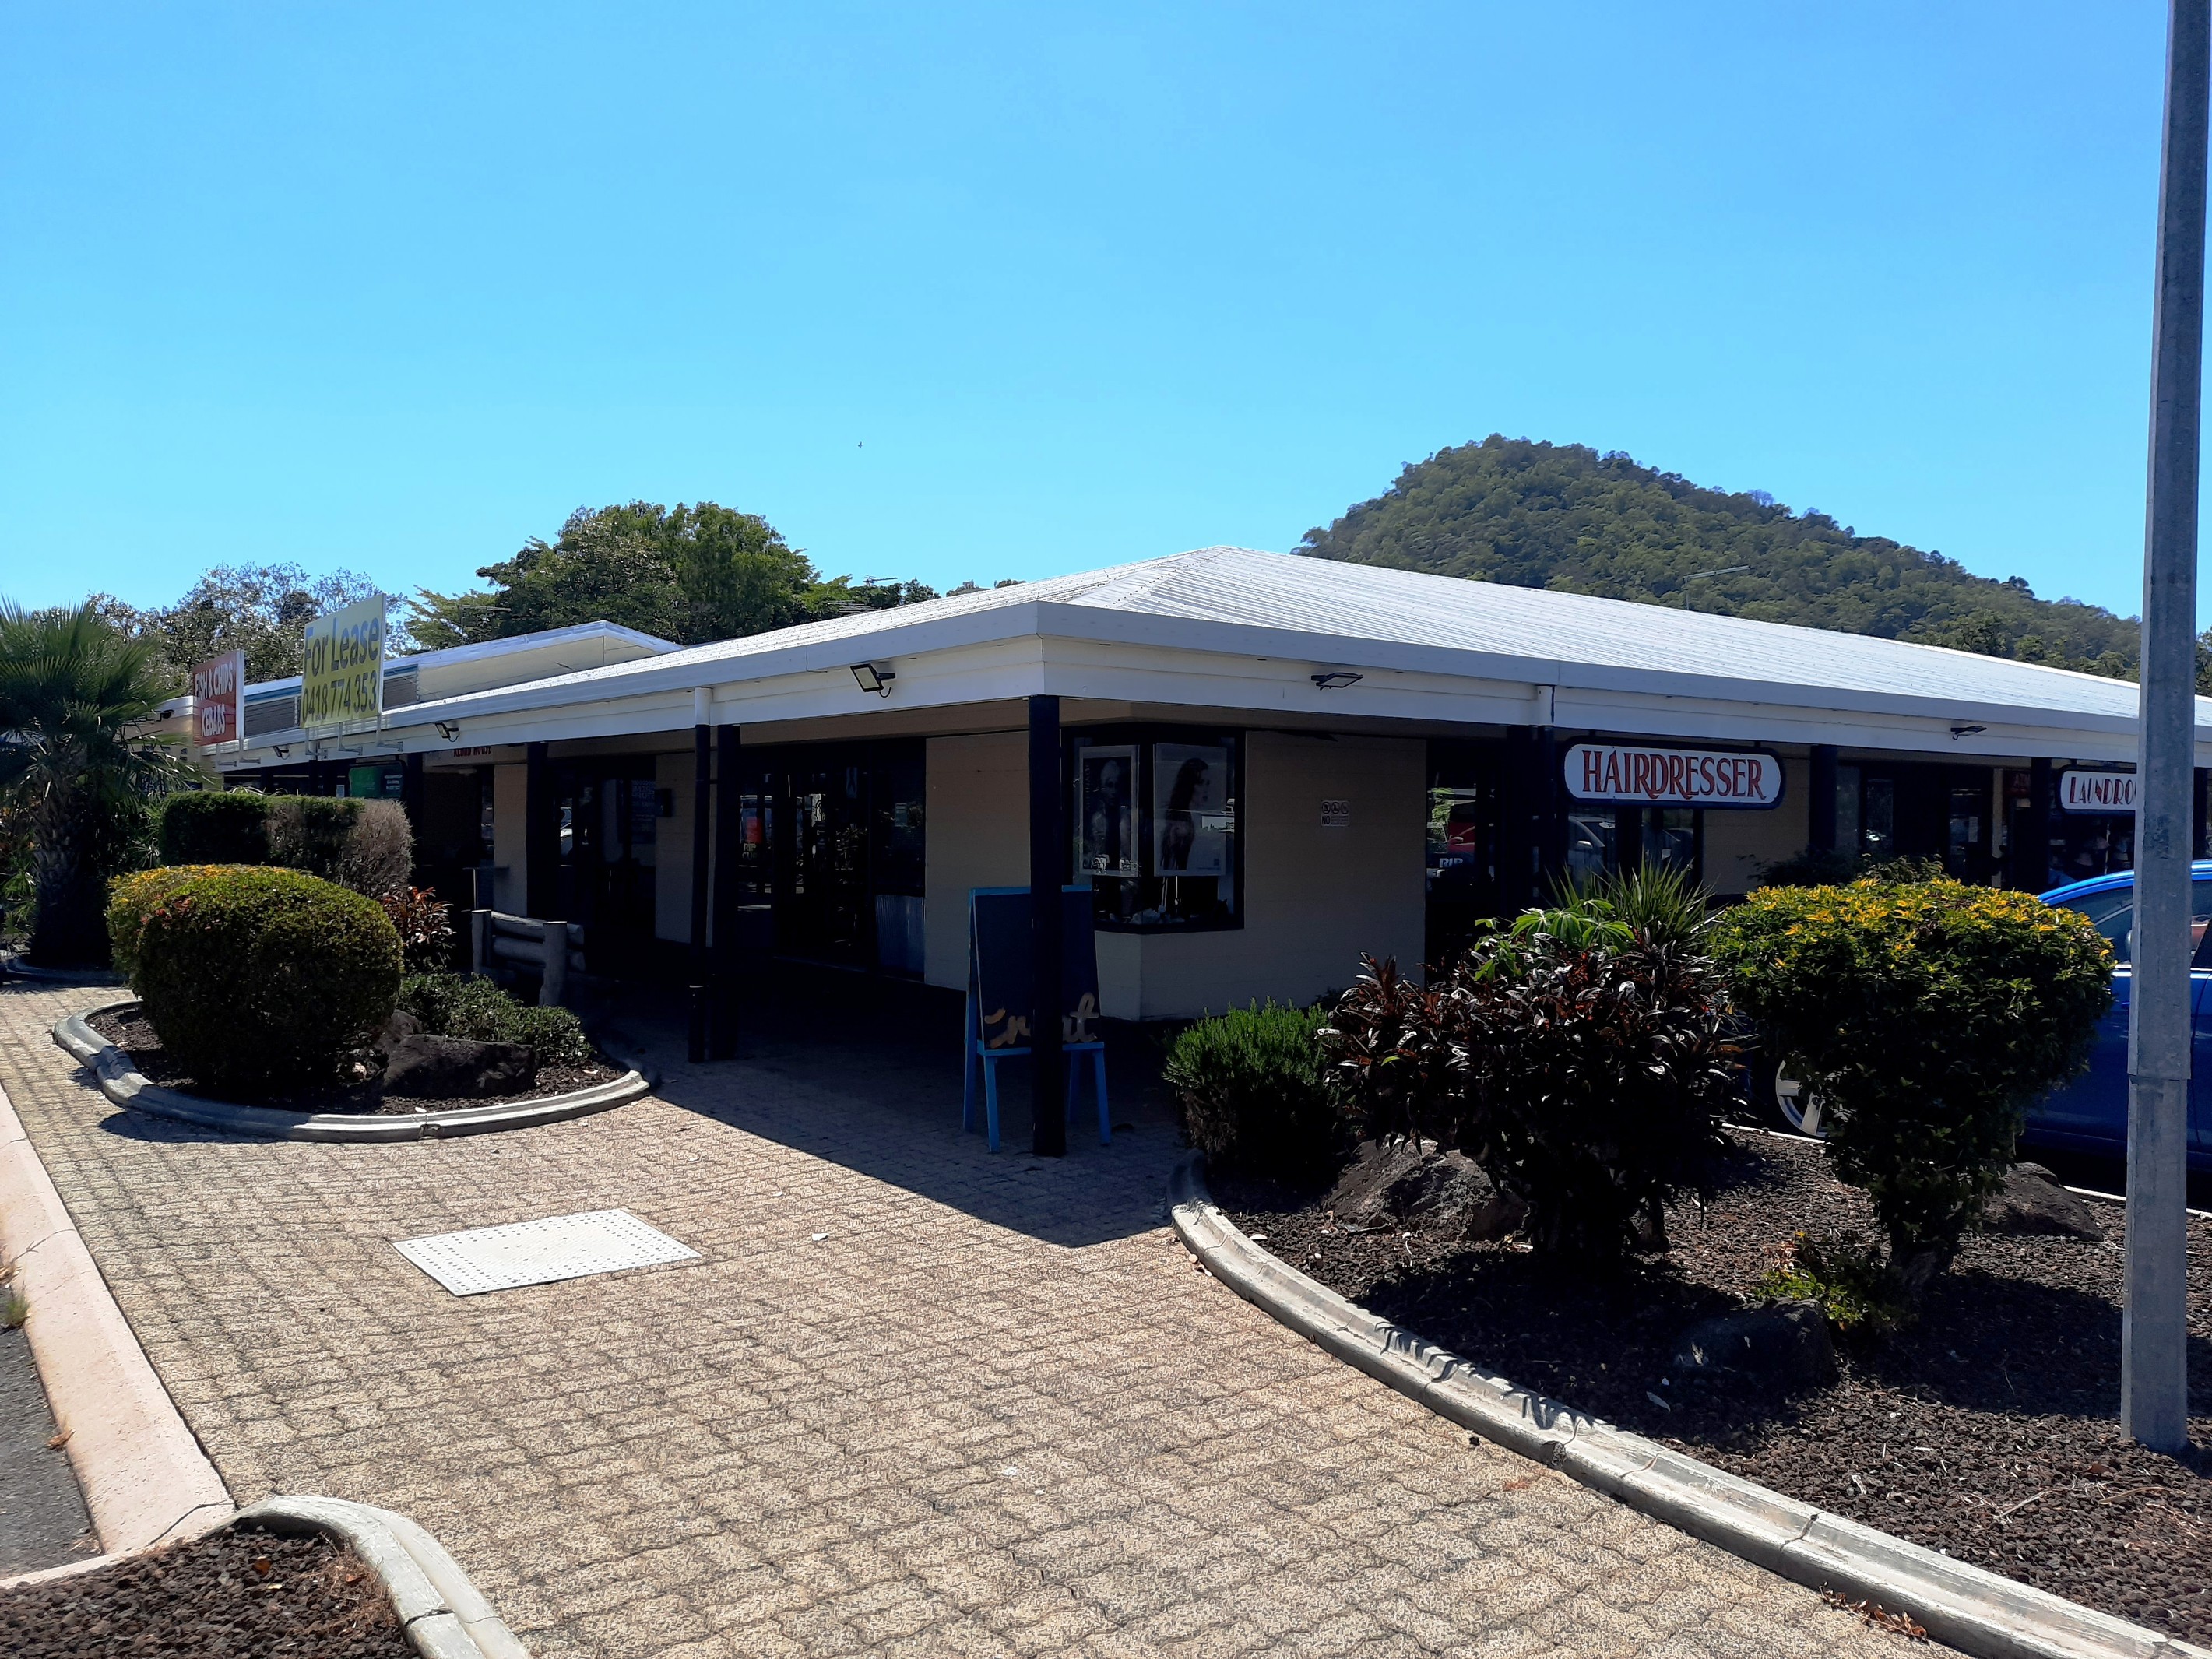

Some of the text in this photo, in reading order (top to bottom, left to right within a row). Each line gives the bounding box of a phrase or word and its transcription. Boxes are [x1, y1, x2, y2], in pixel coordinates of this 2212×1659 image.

[304, 617, 380, 680] For Lease
[195, 660, 234, 701] FISH & CHIPS
[302, 670, 377, 722] 0418 774 353
[201, 703, 226, 737] KEBABS
[1582, 750, 1767, 800] HAIRDRESSER
[2070, 776, 2136, 805] LAUNDRO
